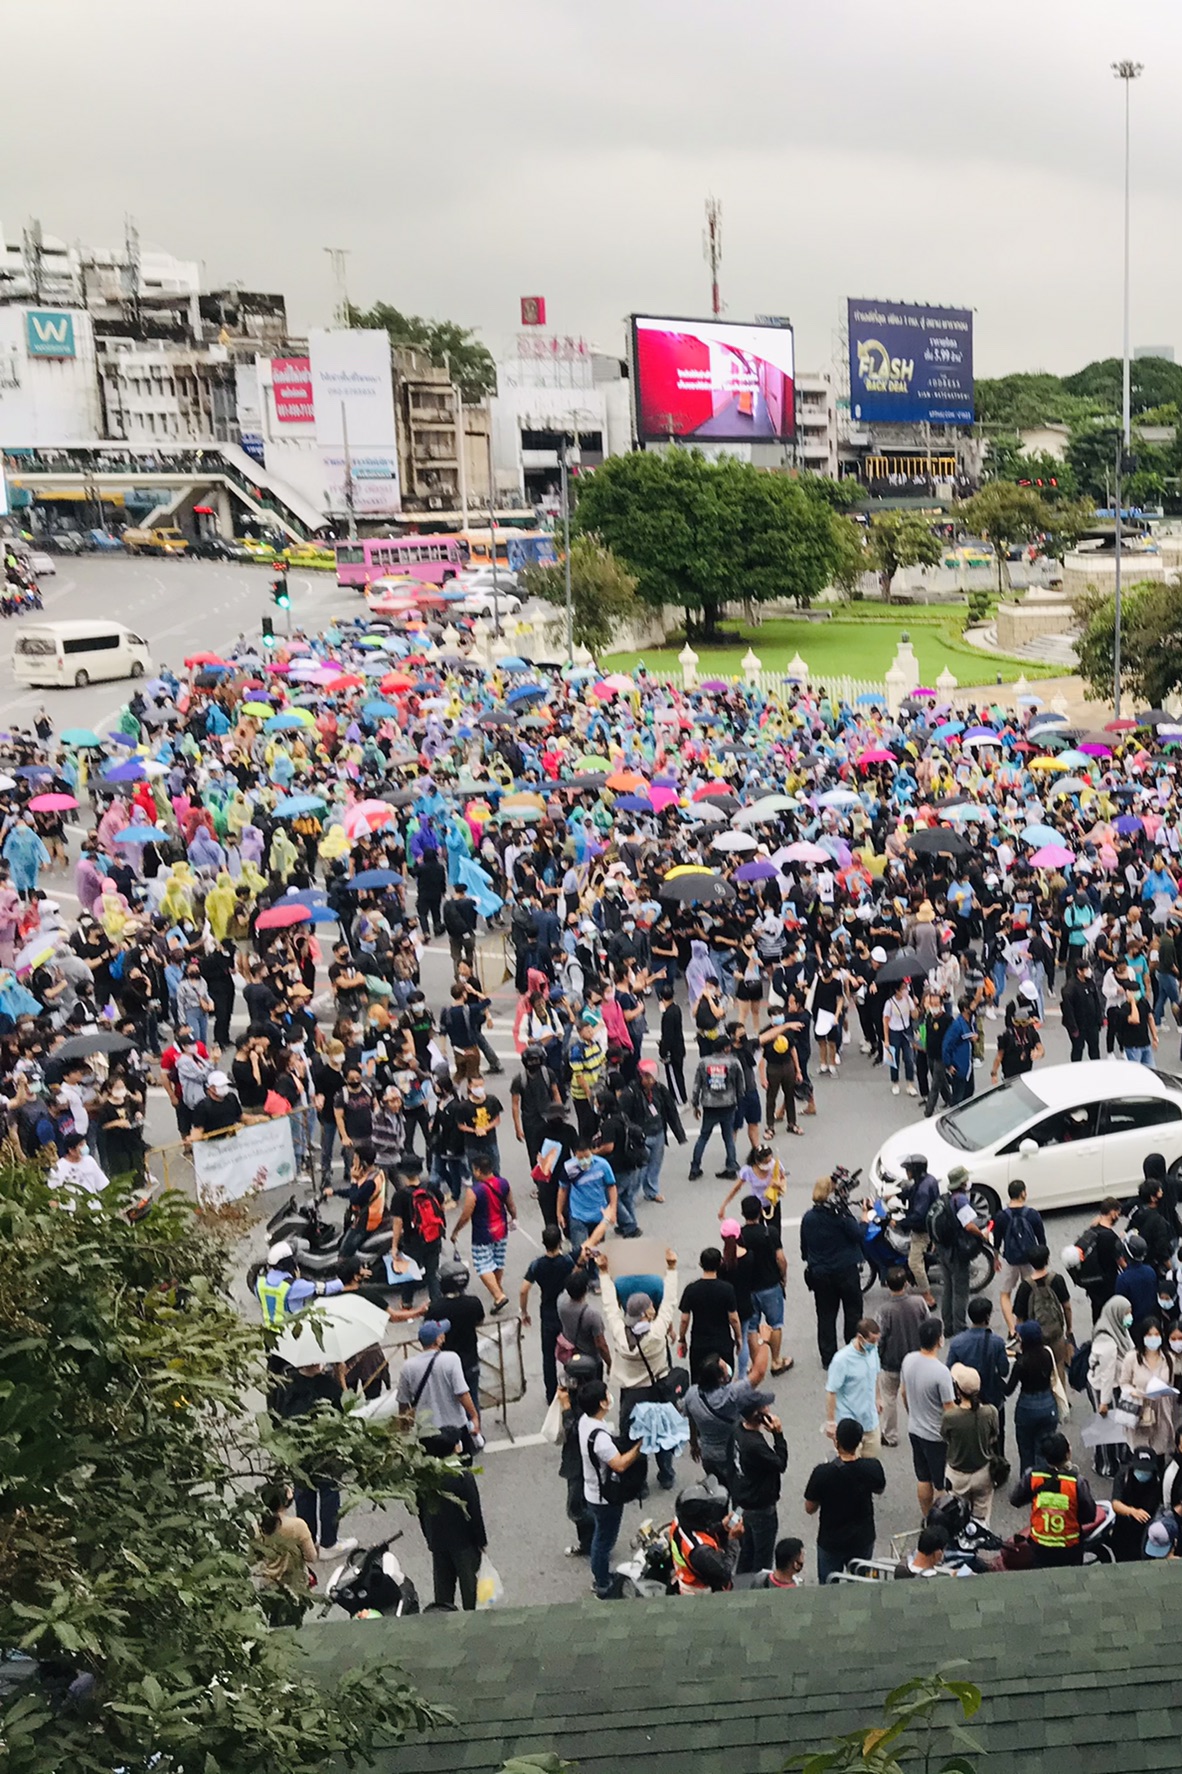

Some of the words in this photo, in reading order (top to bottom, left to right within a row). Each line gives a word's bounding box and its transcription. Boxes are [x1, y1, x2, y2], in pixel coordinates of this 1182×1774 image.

[32, 316, 67, 342] W
[858, 355, 915, 381] FLASH
[1041, 1512, 1065, 1533] 19
